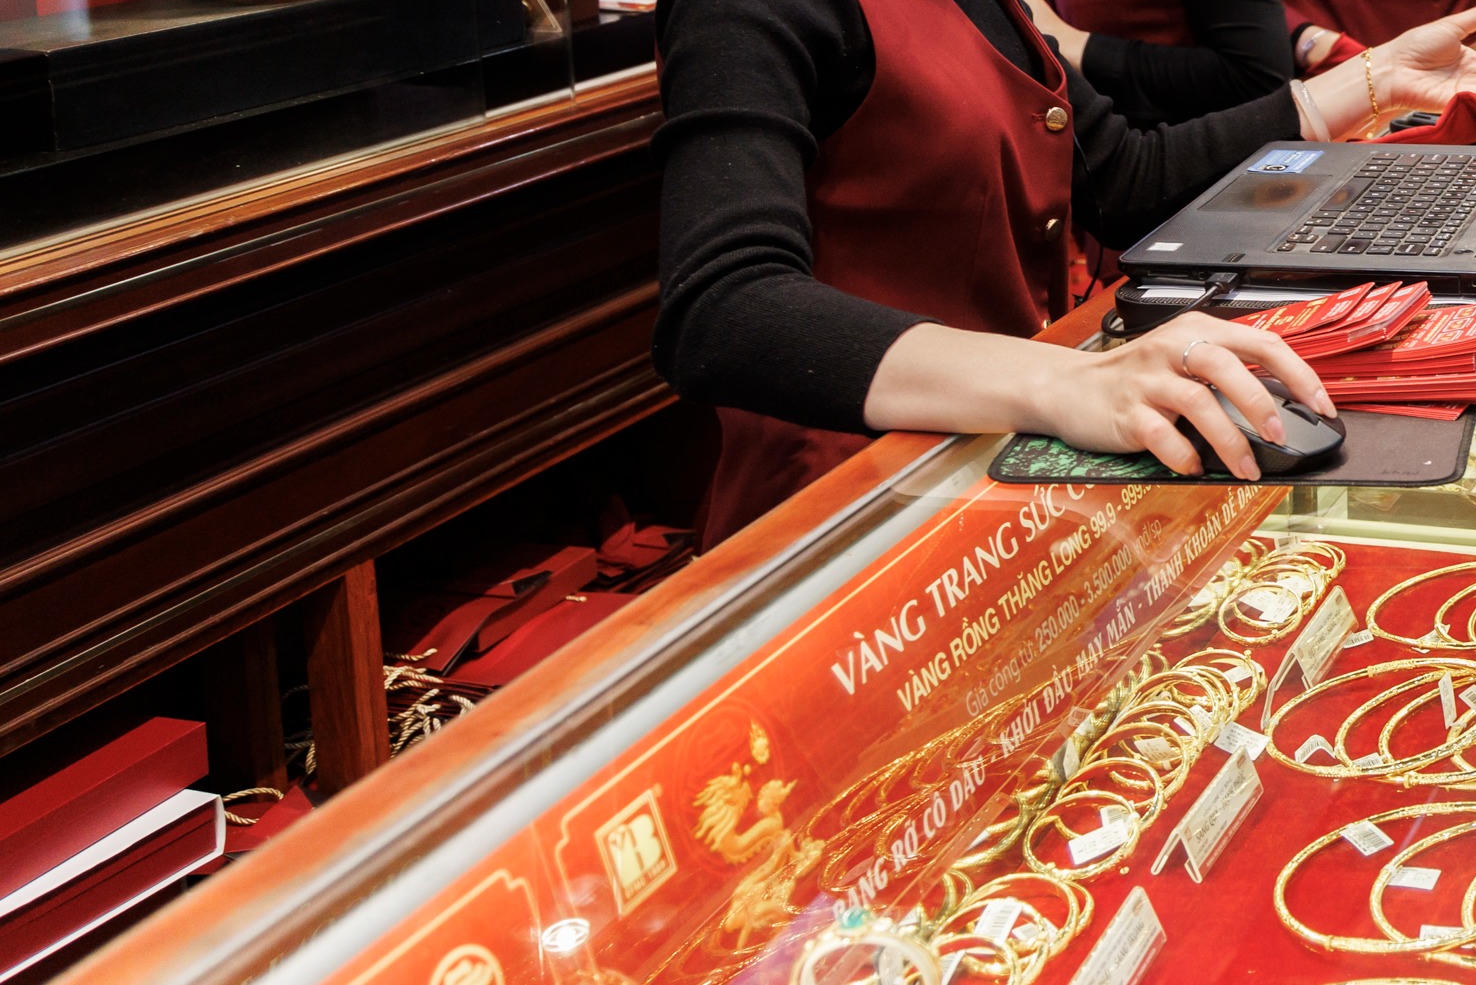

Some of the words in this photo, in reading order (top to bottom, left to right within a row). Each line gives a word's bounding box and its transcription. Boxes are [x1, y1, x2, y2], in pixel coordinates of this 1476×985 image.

[831, 598, 927, 696] VÀNG
[925, 521, 1020, 619] TRANG
[1019, 483, 1066, 544] SỨC
[896, 652, 952, 713] VÀNG
[949, 608, 1001, 666] RỒNG
[997, 561, 1052, 621] THĂNG
[1050, 524, 1092, 576] LONG
[1089, 501, 1118, 539] 99.9
[964, 678, 989, 717] Giá
[988, 654, 1021, 698] công
[1034, 595, 1079, 652] 250.000
[1083, 542, 1132, 605] 3.500.000
[922, 790, 947, 839] CÔ
[1075, 631, 1105, 677] MAY
[1143, 556, 1185, 607] THANH
